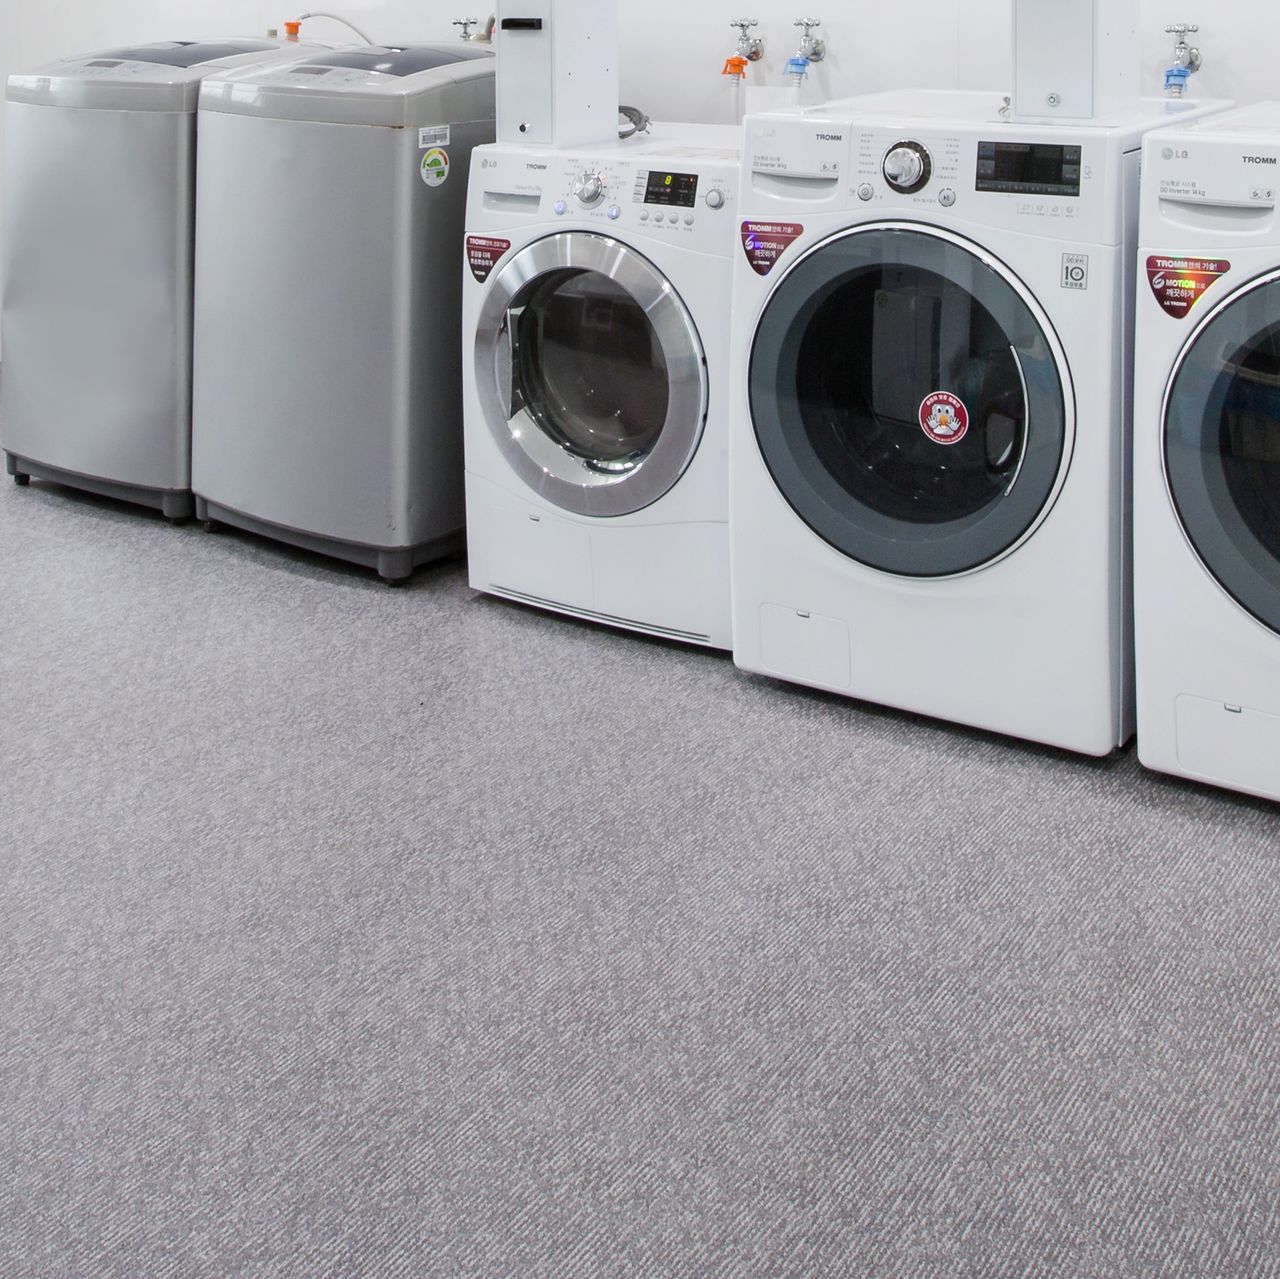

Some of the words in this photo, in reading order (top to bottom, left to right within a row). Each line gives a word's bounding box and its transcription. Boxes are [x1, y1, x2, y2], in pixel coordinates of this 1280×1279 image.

[1175, 150, 1189, 159] LG
[1242, 156, 1277, 164] TROMM
[526, 163, 547, 171] TROMM
